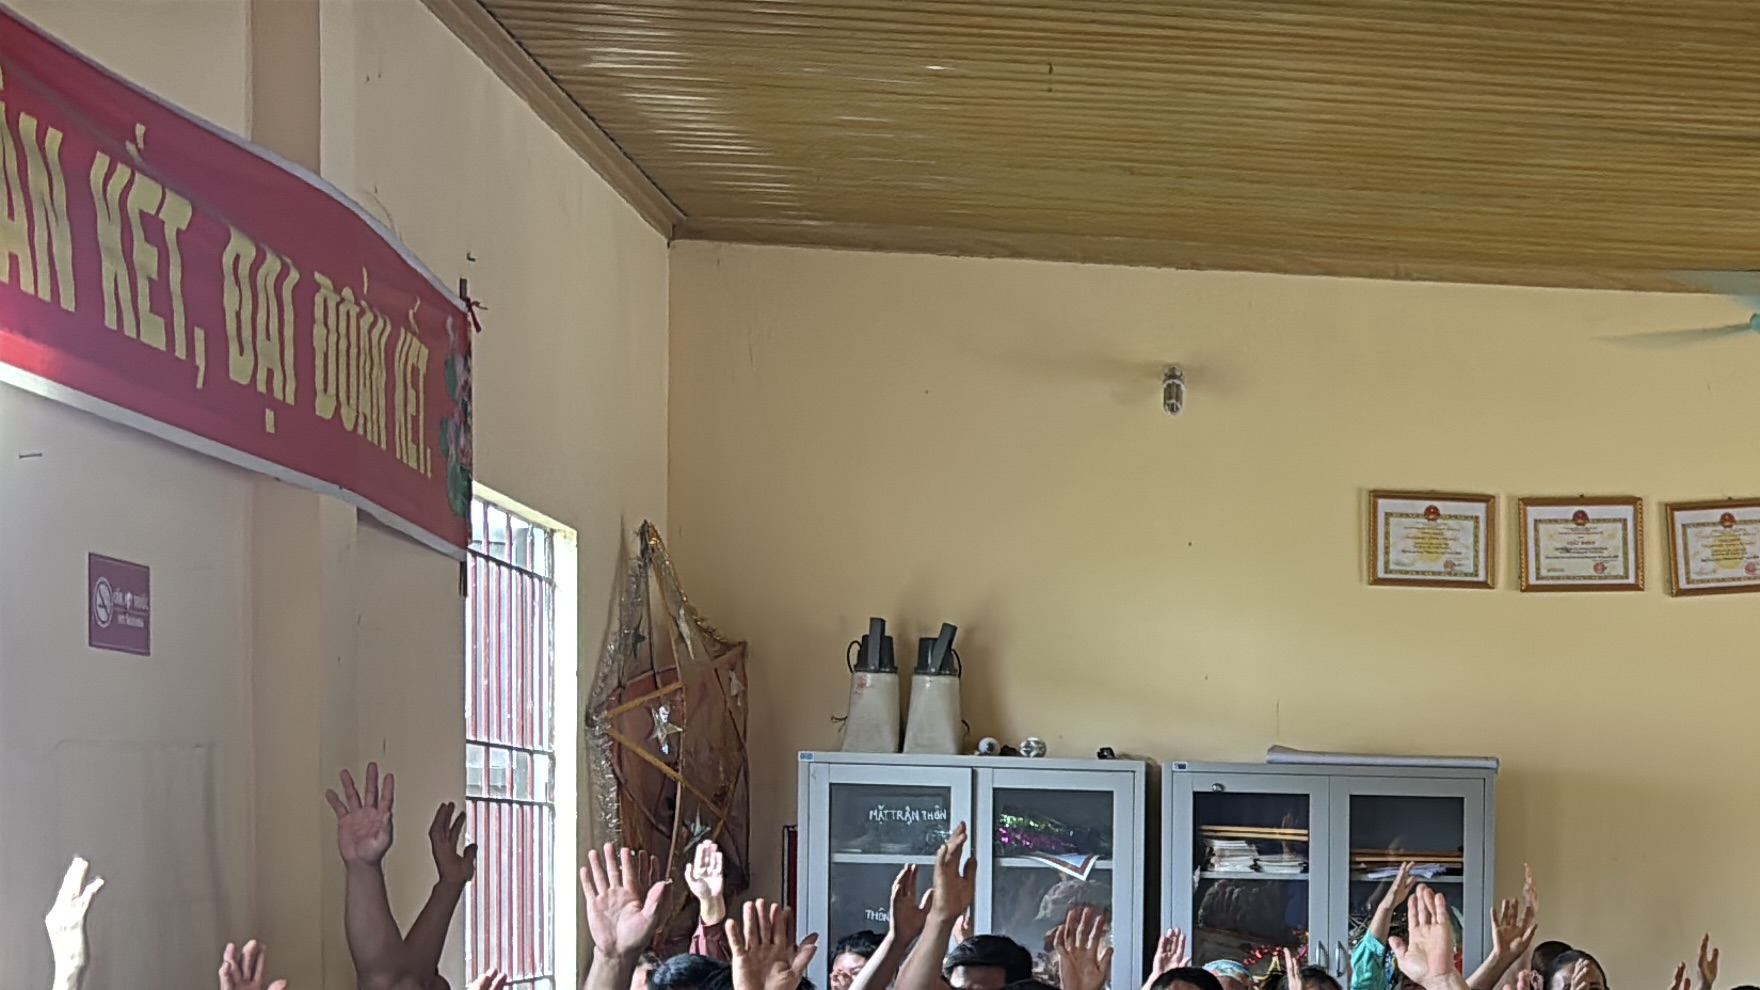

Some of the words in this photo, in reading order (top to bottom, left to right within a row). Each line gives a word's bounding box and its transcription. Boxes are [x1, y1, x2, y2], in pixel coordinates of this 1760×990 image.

[90, 123, 206, 389] KẾT,
[222, 224, 300, 434] ĐẠI
[313, 265, 392, 451] ĐOÀN
[394, 296, 432, 479] KẾT.
[921, 804, 947, 820] THÔN
